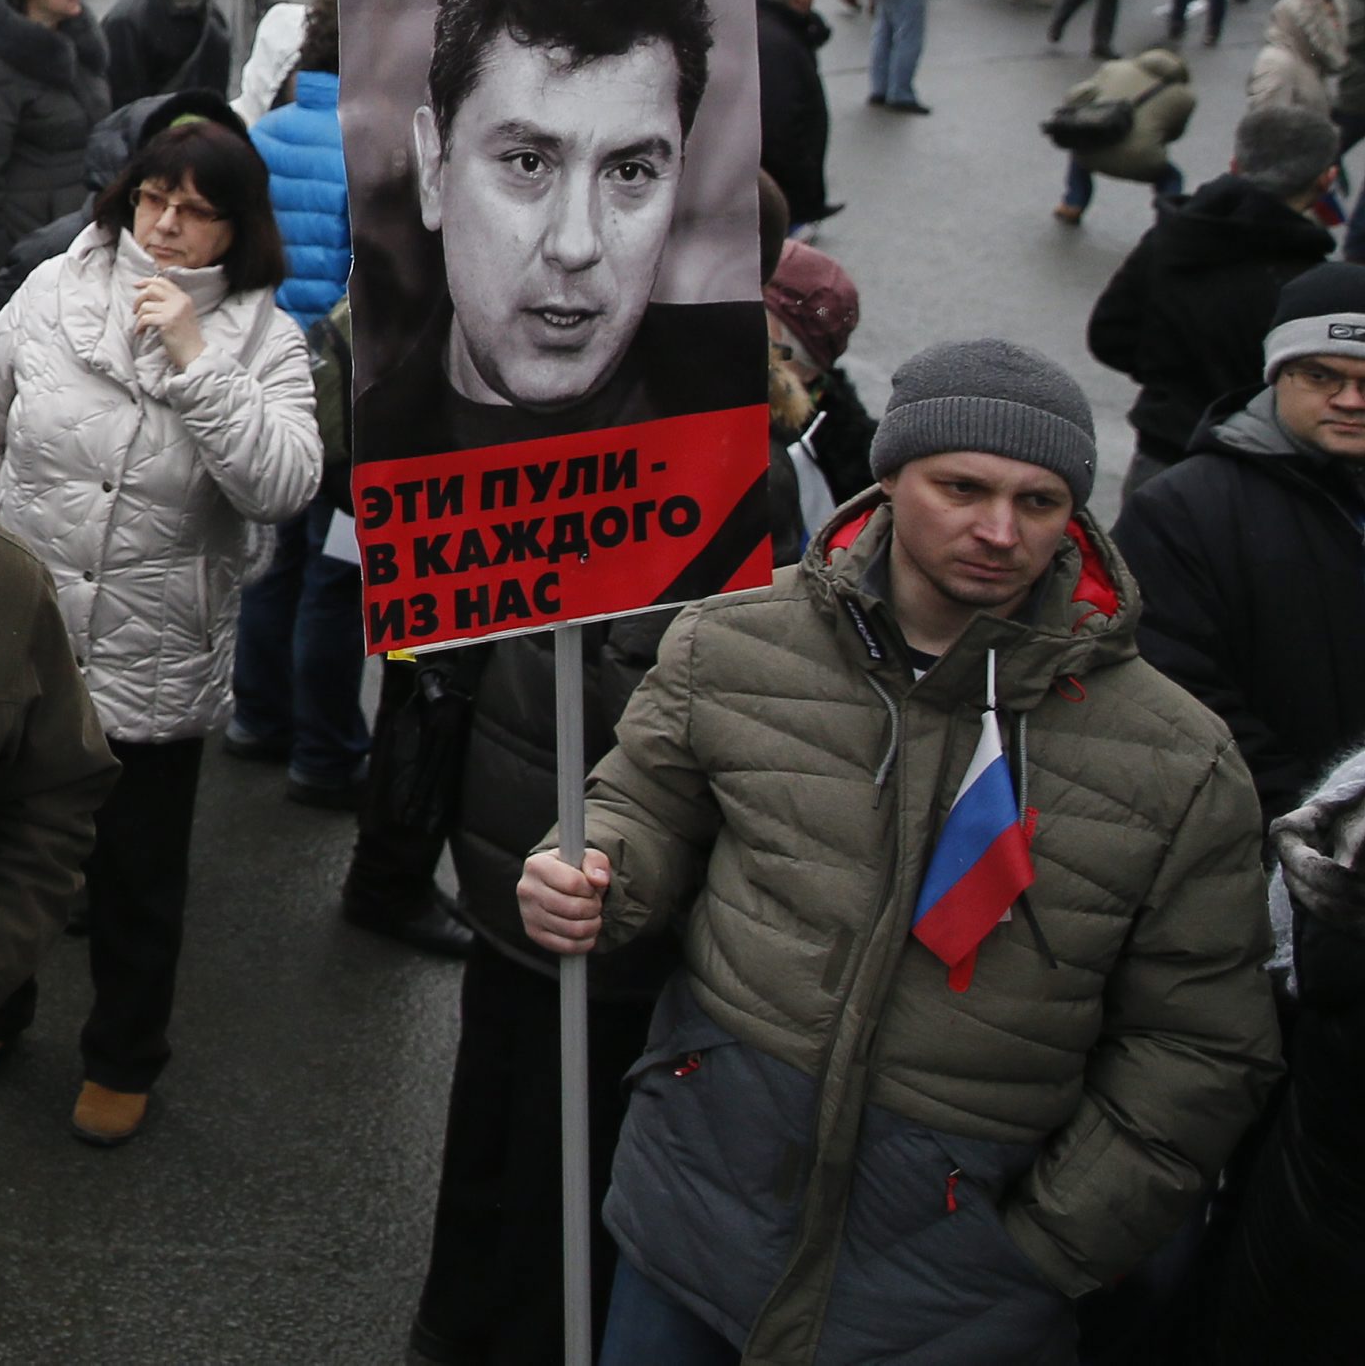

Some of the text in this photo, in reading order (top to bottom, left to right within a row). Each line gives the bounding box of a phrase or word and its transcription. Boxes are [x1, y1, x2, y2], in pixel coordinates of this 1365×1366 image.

[360, 448, 667, 531] ЭТИ ПУЛИ -
[365, 494, 702, 587] В КАЖДОГО
[369, 571, 562, 645] ИЗ НАС
